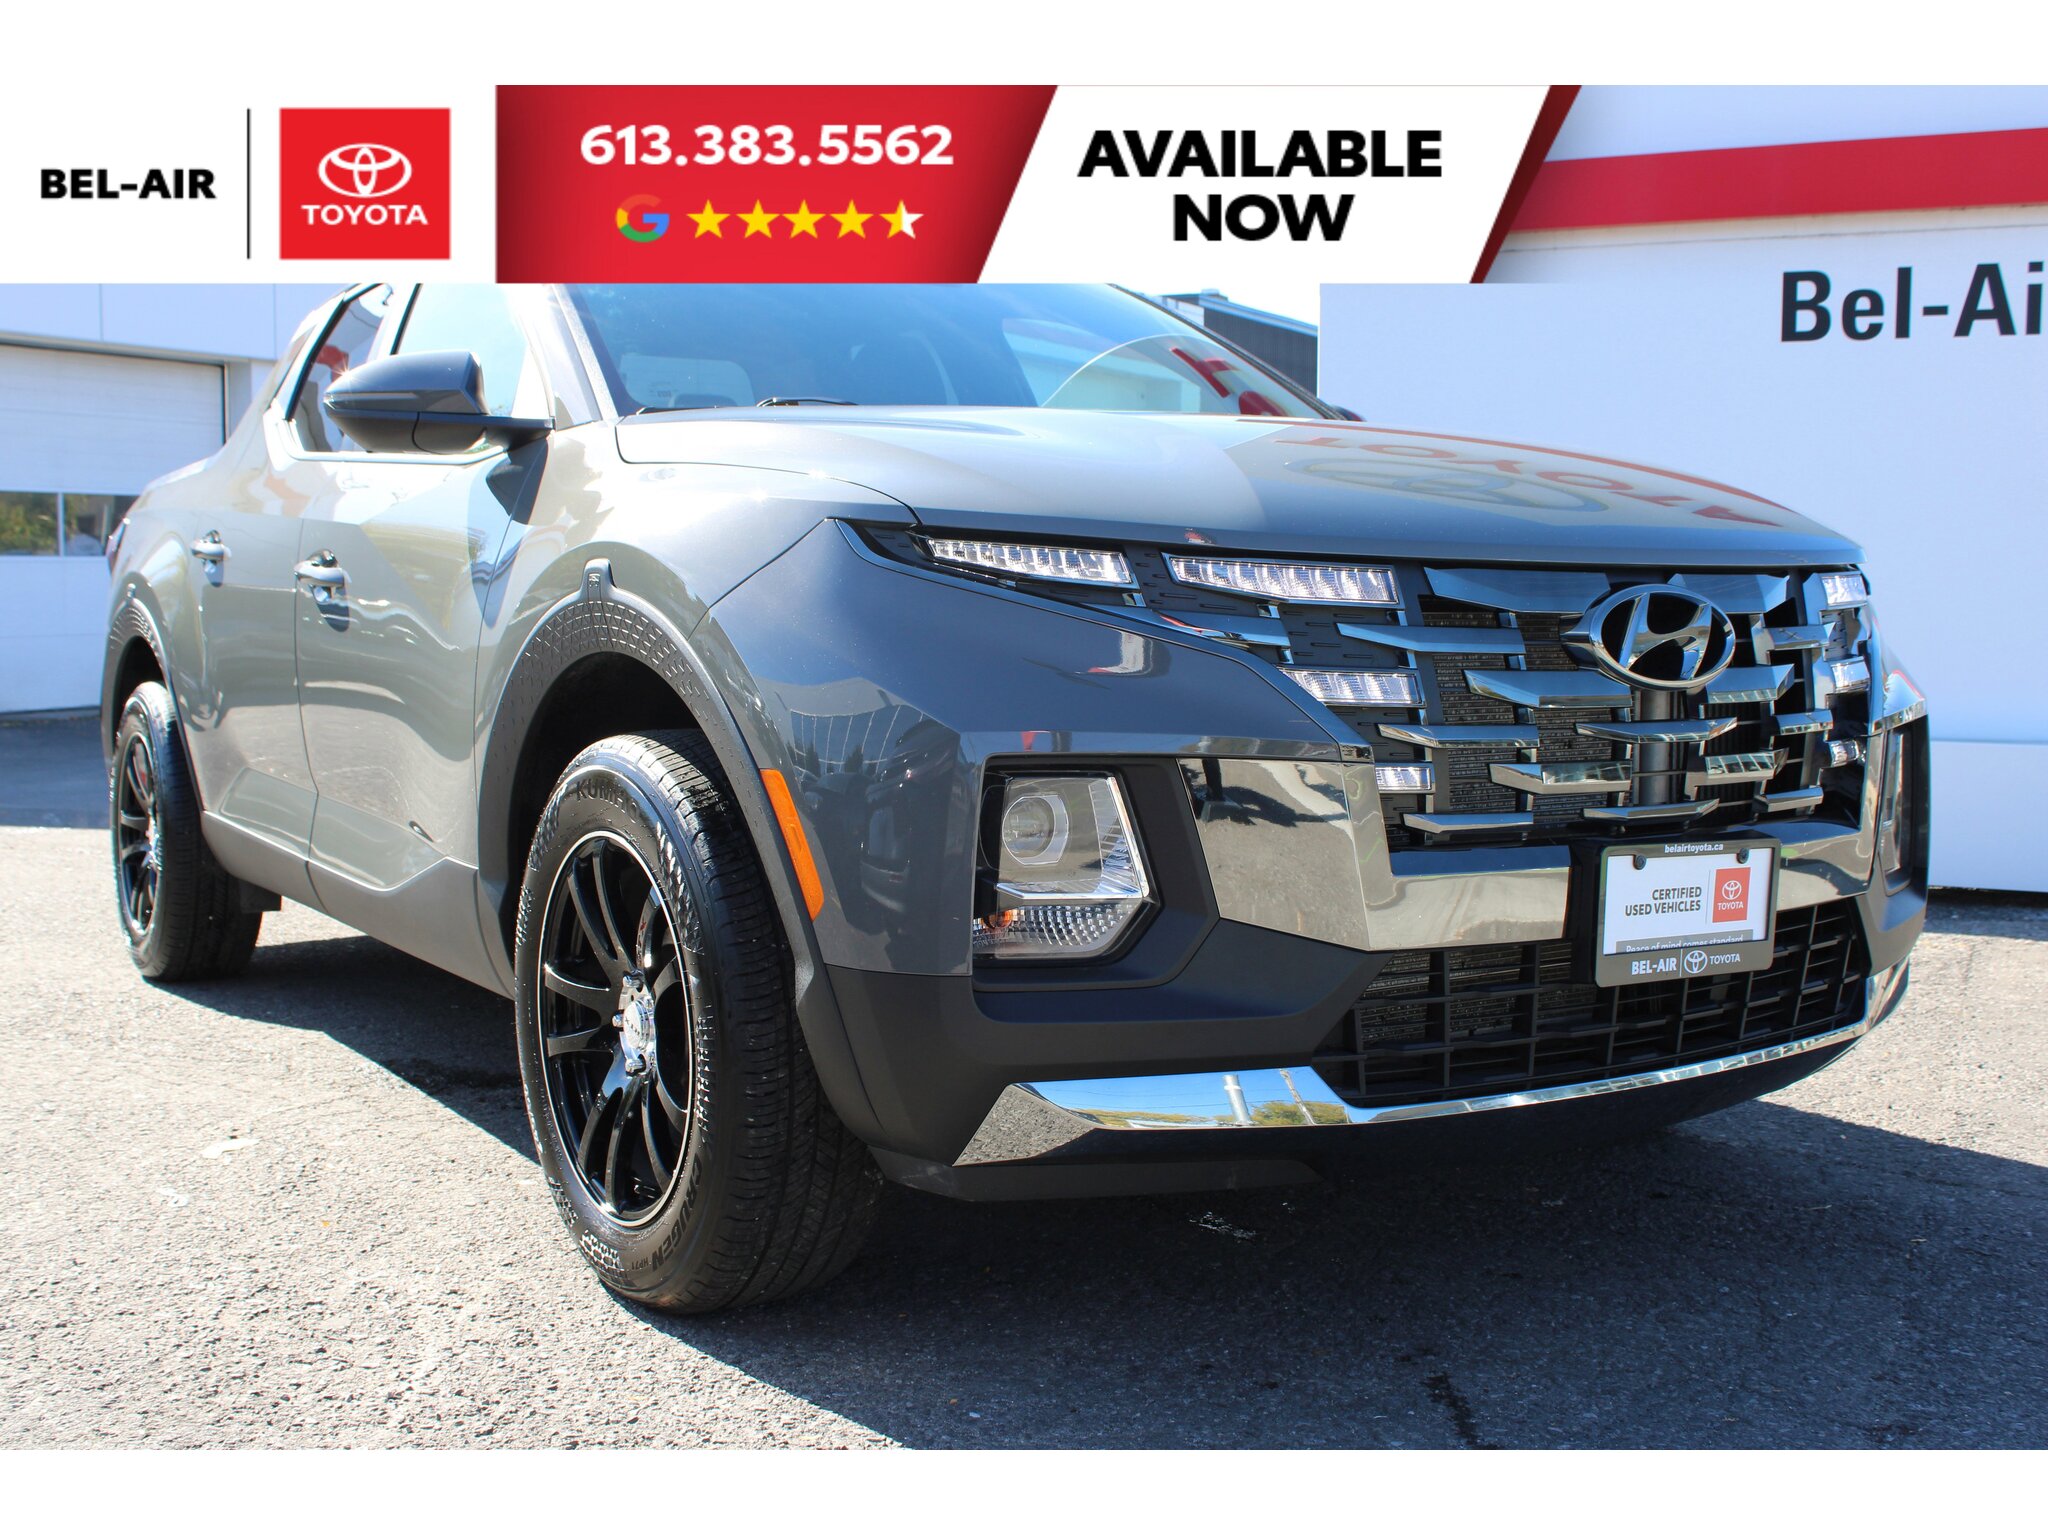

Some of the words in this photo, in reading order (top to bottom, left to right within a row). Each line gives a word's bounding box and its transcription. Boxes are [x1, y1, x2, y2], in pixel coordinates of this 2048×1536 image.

[1781, 261, 2045, 342] Bel-Ai
[1664, 843, 1724, 853] belairtoyota.ca
[1652, 886, 1702, 900] CERTIFIED
[1625, 903, 1652, 916] USED
[1654, 900, 1701, 914] VEHICLES
[1717, 901, 1744, 910] TOYOTA
[1631, 957, 1677, 975] BEL-AIR
[1709, 953, 1741, 964] TOYOTA
[652, 1152, 703, 1272] CRUGEN
